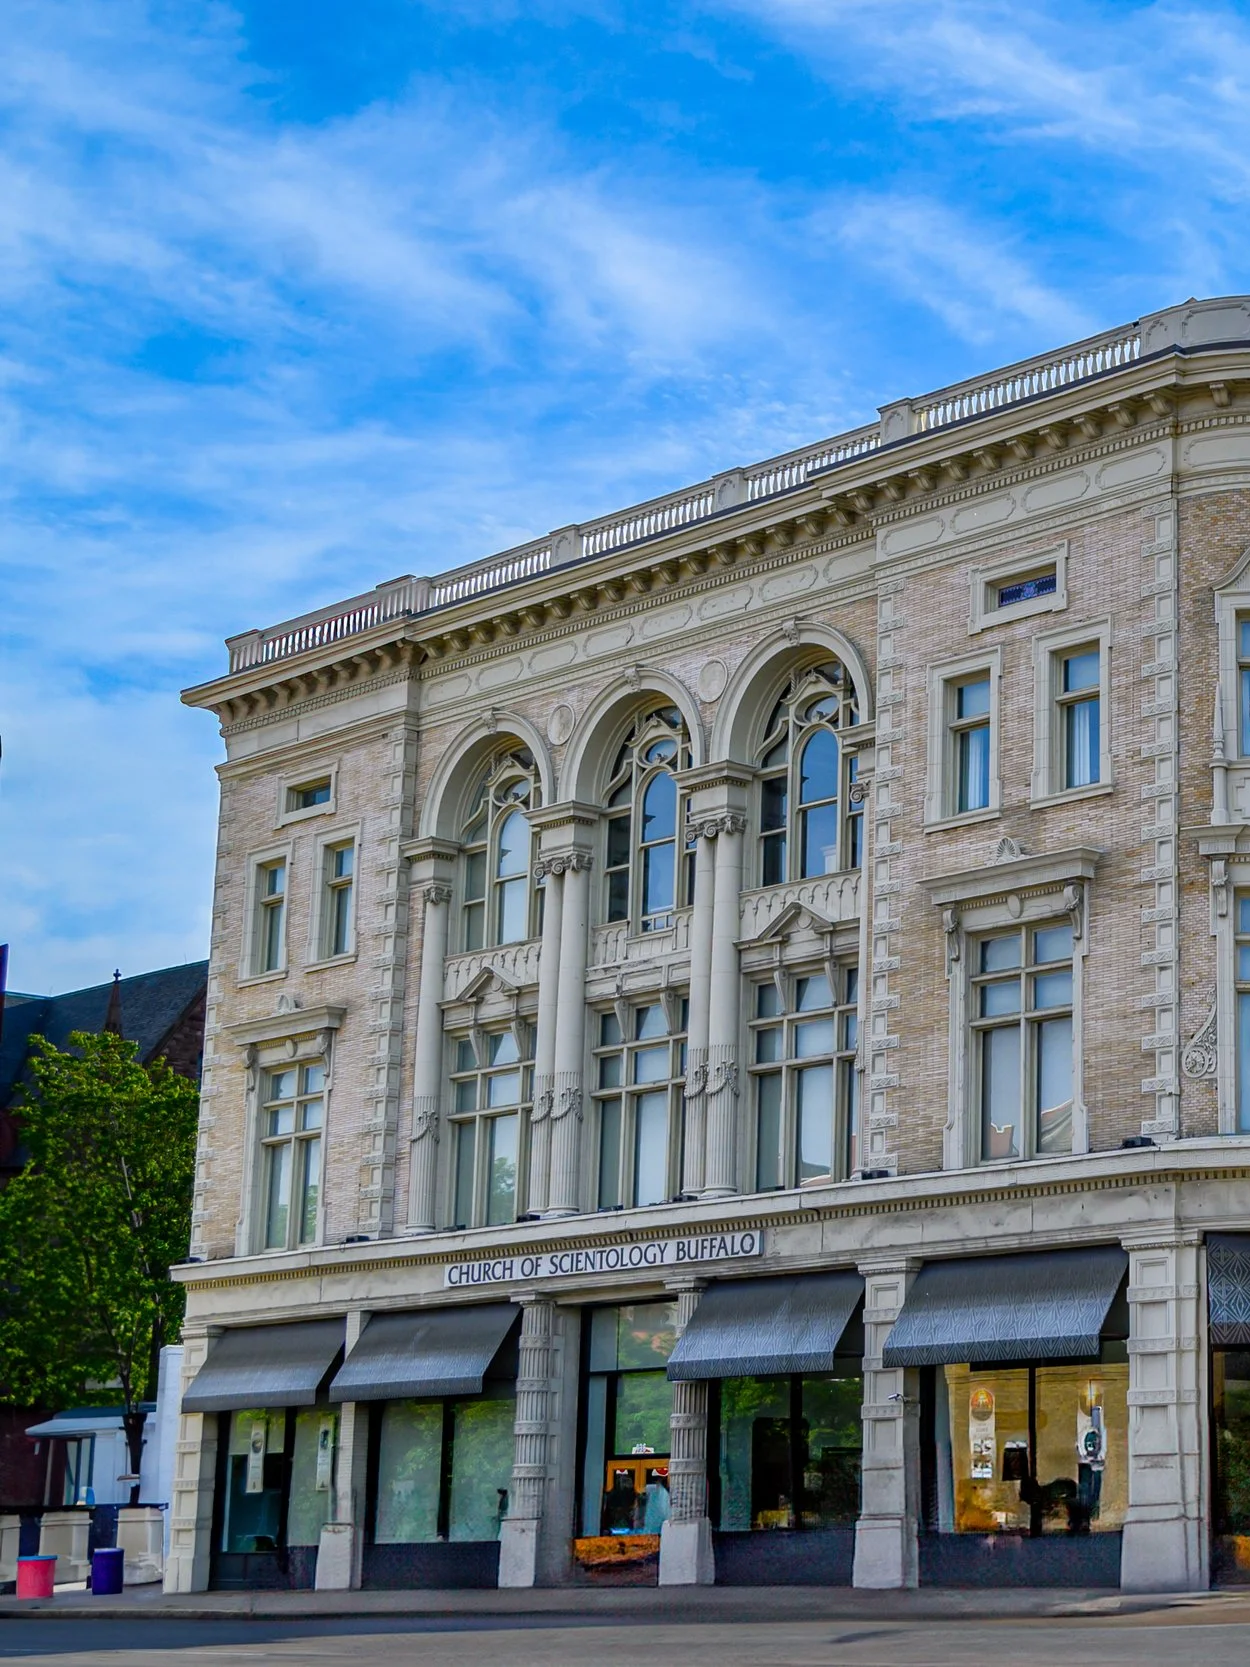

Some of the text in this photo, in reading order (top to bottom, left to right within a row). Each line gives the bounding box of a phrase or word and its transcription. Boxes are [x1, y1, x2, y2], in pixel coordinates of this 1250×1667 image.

[448, 1233, 755, 1285] CHURCH OF SCIENTOLOGY BUFFALO
